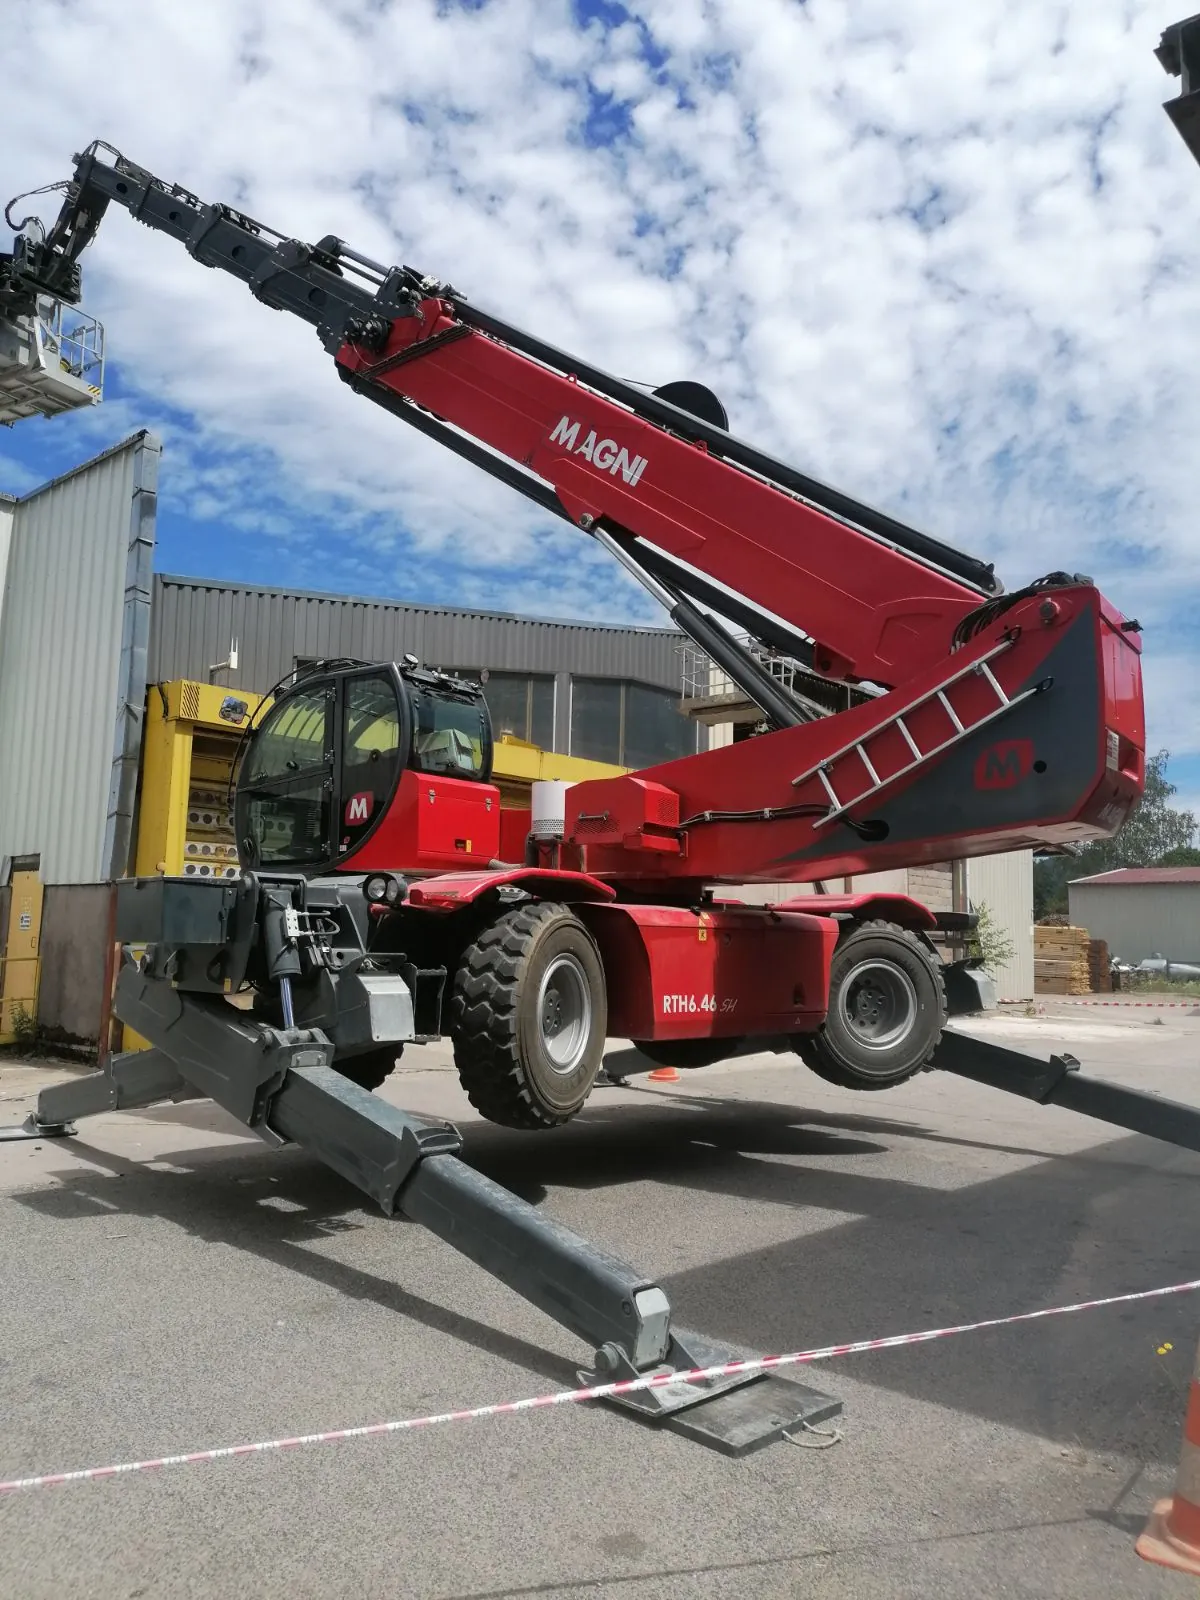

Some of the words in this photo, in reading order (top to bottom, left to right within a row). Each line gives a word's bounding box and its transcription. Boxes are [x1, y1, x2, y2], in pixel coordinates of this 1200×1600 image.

[549, 416, 648, 487] MAGNI
[986, 750, 1019, 779] M
[349, 797, 368, 819] M
[663, 994, 717, 1013] RTH6.46
[720, 998, 738, 1012] SH
